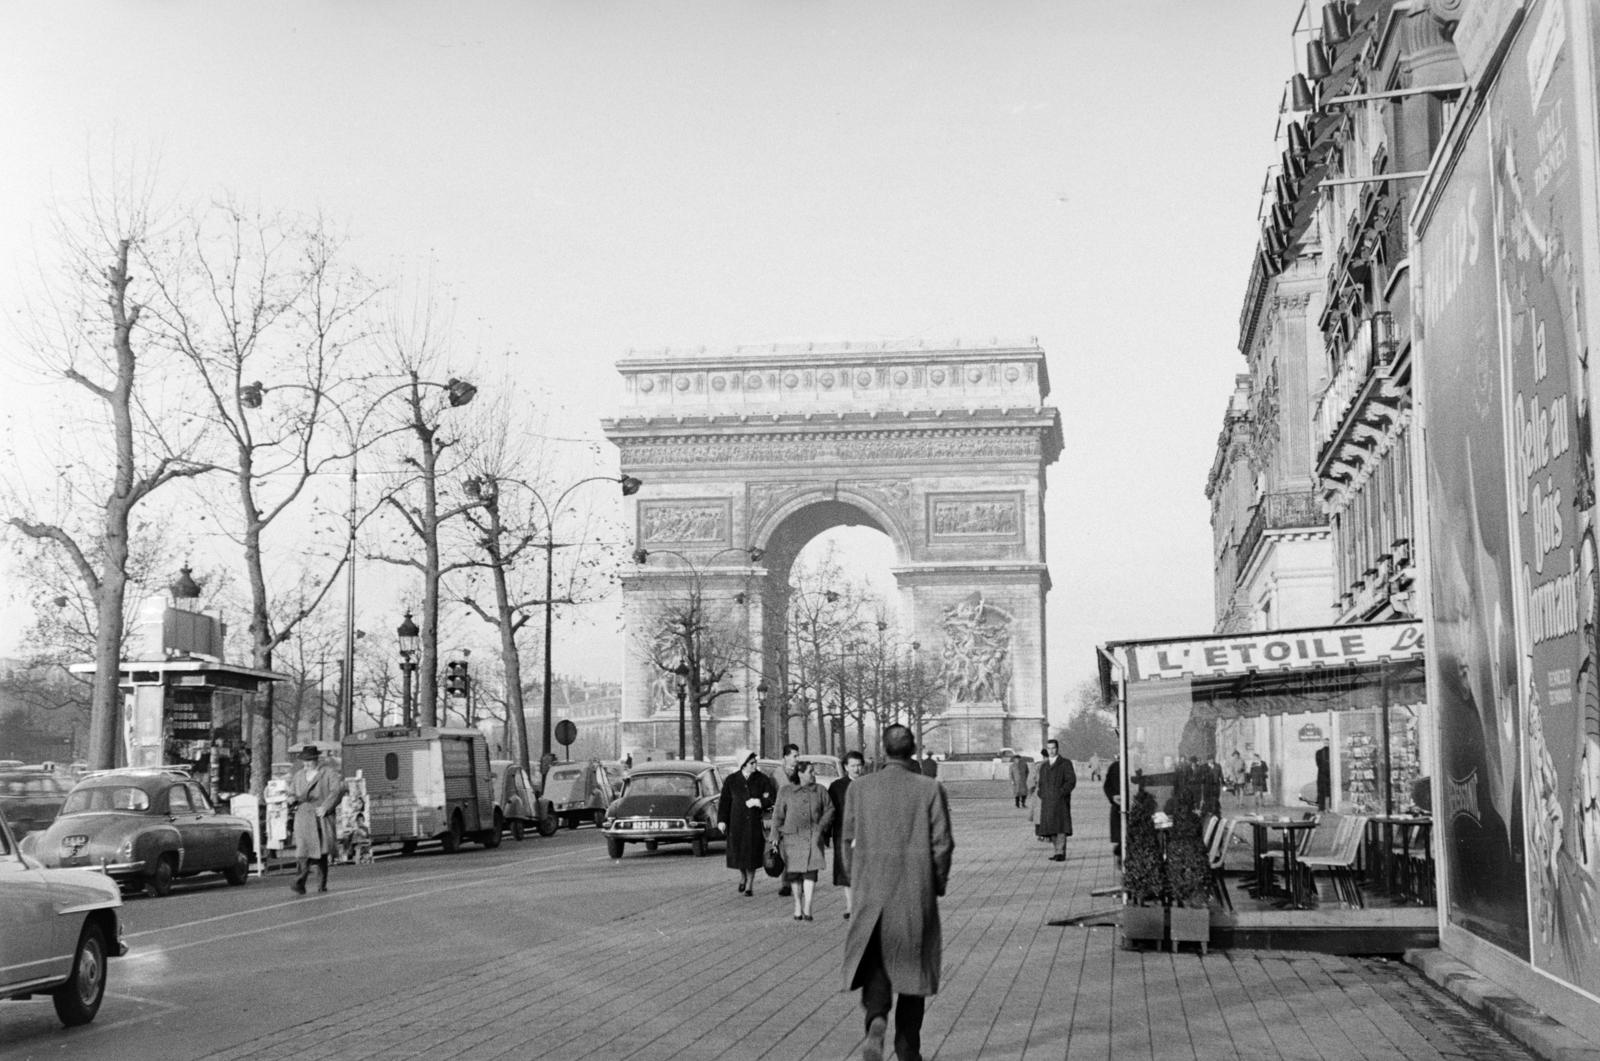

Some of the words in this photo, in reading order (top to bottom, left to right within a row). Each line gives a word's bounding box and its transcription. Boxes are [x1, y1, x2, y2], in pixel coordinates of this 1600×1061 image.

[1535, 128, 1568, 197] DISNEY
[1424, 187, 1479, 340] PHILIPS
[1531, 307, 1547, 383] La
[1515, 392, 1549, 514] Belle
[1551, 394, 1569, 459] au
[1532, 476, 1562, 573] Bois
[1522, 548, 1579, 656] Dormant
[1157, 634, 1366, 671] L'ETOILE
